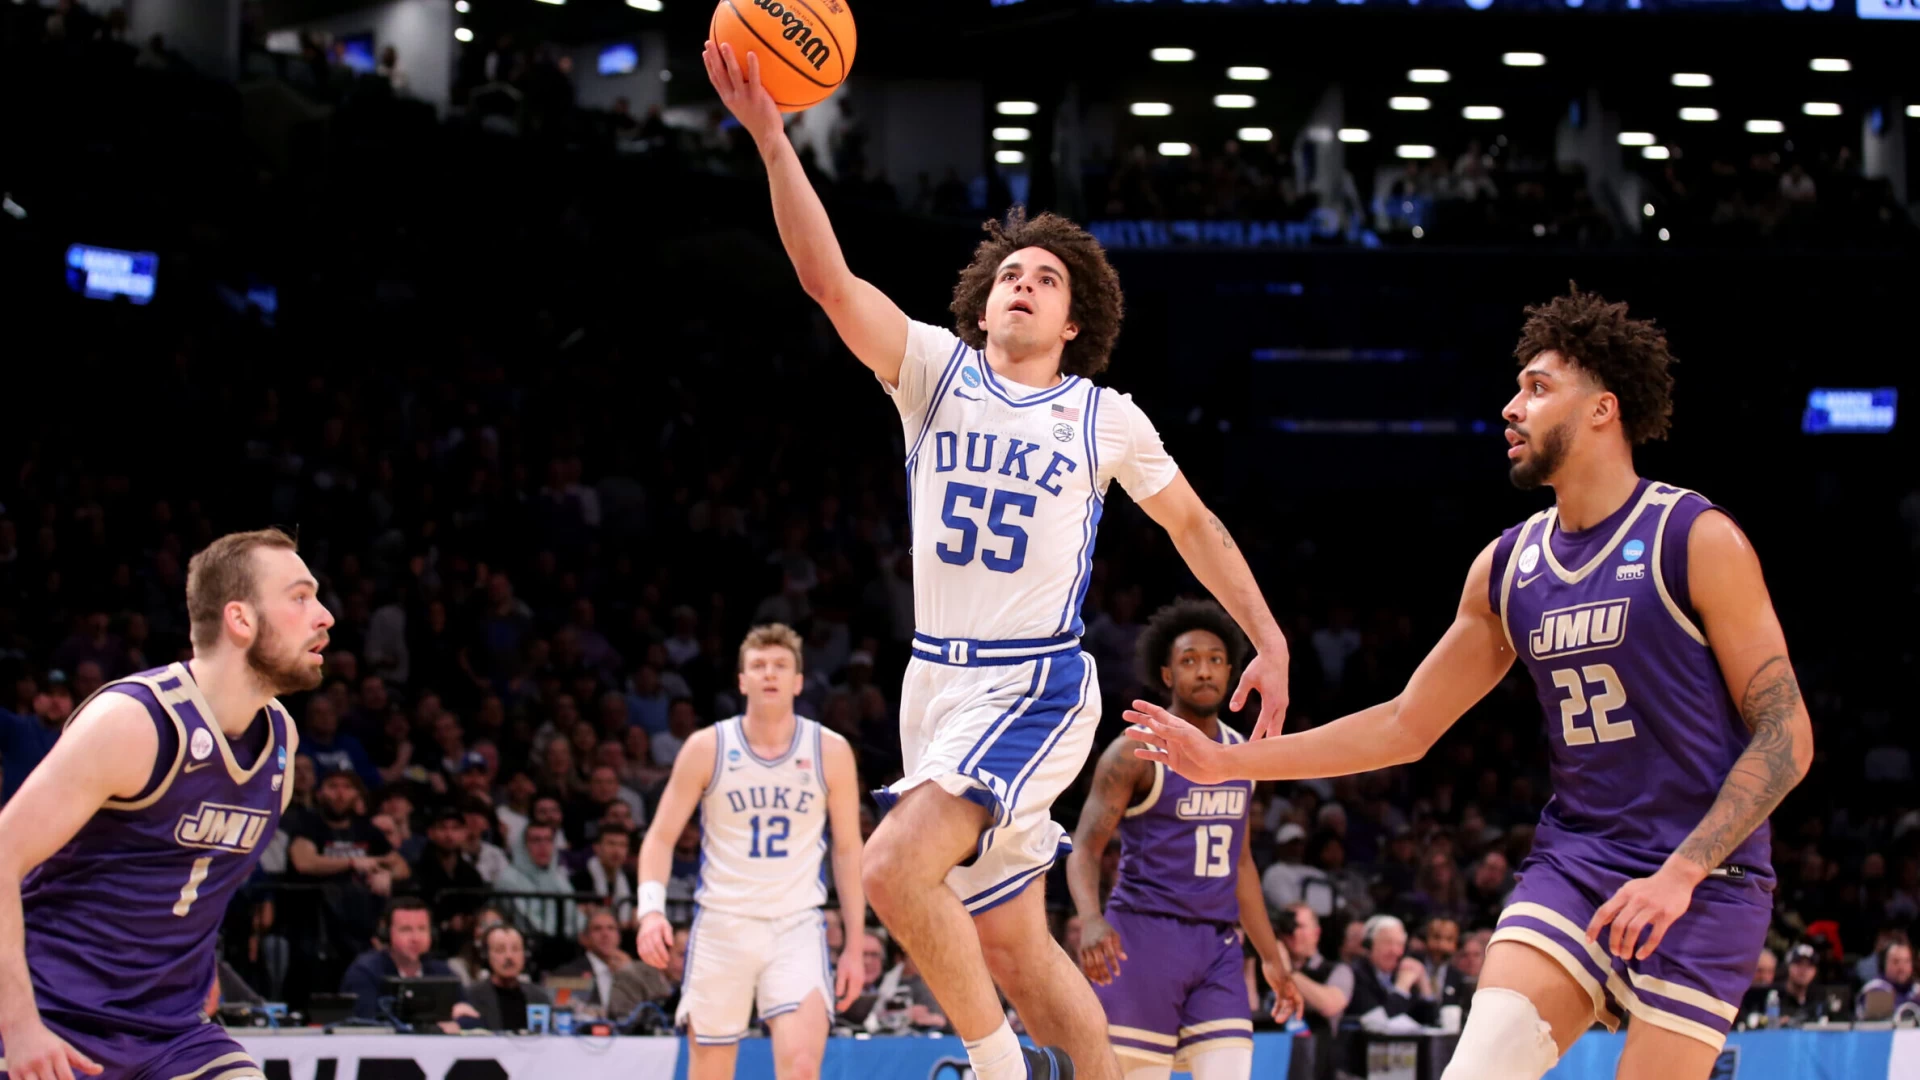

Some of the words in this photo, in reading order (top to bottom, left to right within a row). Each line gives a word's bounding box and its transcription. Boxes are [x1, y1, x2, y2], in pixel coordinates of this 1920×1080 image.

[935, 431, 1077, 497] DUKE
[936, 481, 1037, 574] 55
[1533, 604, 1624, 655] JMU
[1551, 664, 1636, 746] 22
[726, 786, 815, 814] DUKE
[1179, 790, 1245, 816] JMU
[181, 808, 269, 849] JMU
[748, 814, 791, 858] 12
[1194, 824, 1233, 877] 13
[172, 857, 213, 917] 1
